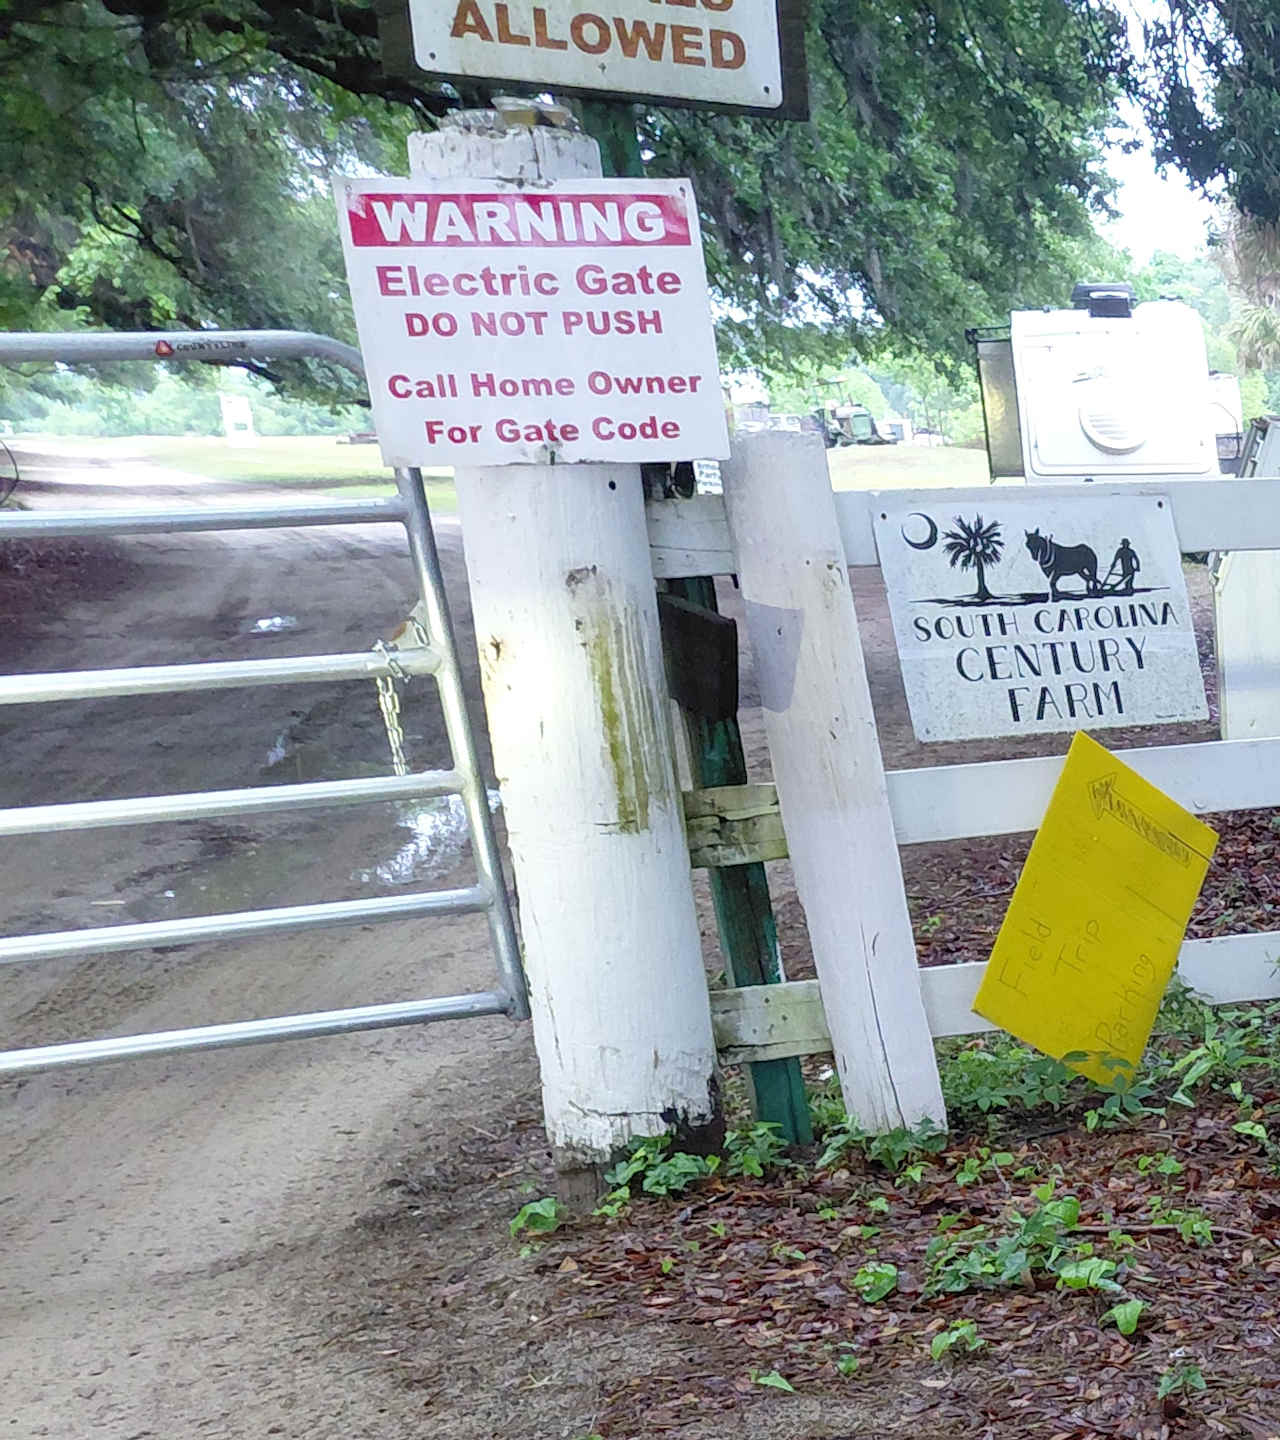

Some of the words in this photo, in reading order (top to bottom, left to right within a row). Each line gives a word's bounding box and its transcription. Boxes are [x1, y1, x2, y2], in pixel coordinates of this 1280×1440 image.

[450, 0, 746, 70] ALLOWED
[374, 202, 667, 243] WARNING
[376, 265, 560, 296] Electric
[576, 264, 682, 295] Gate
[406, 312, 458, 337] DO
[472, 311, 549, 336] NOT
[563, 310, 663, 336] PUSH
[388, 374, 457, 399] Call
[471, 373, 575, 397] Home
[588, 372, 702, 394] Owner
[425, 420, 481, 444] For
[495, 418, 579, 443] Gate
[592, 416, 680, 441] Code
[913, 612, 1019, 642] SOUTH
[1034, 602, 1180, 633] CAROLINA
[956, 635, 1147, 682] CENTURY
[1007, 680, 1124, 722] FARM
[997, 917, 1052, 999] Field
[1052, 919, 1104, 977] Trip
